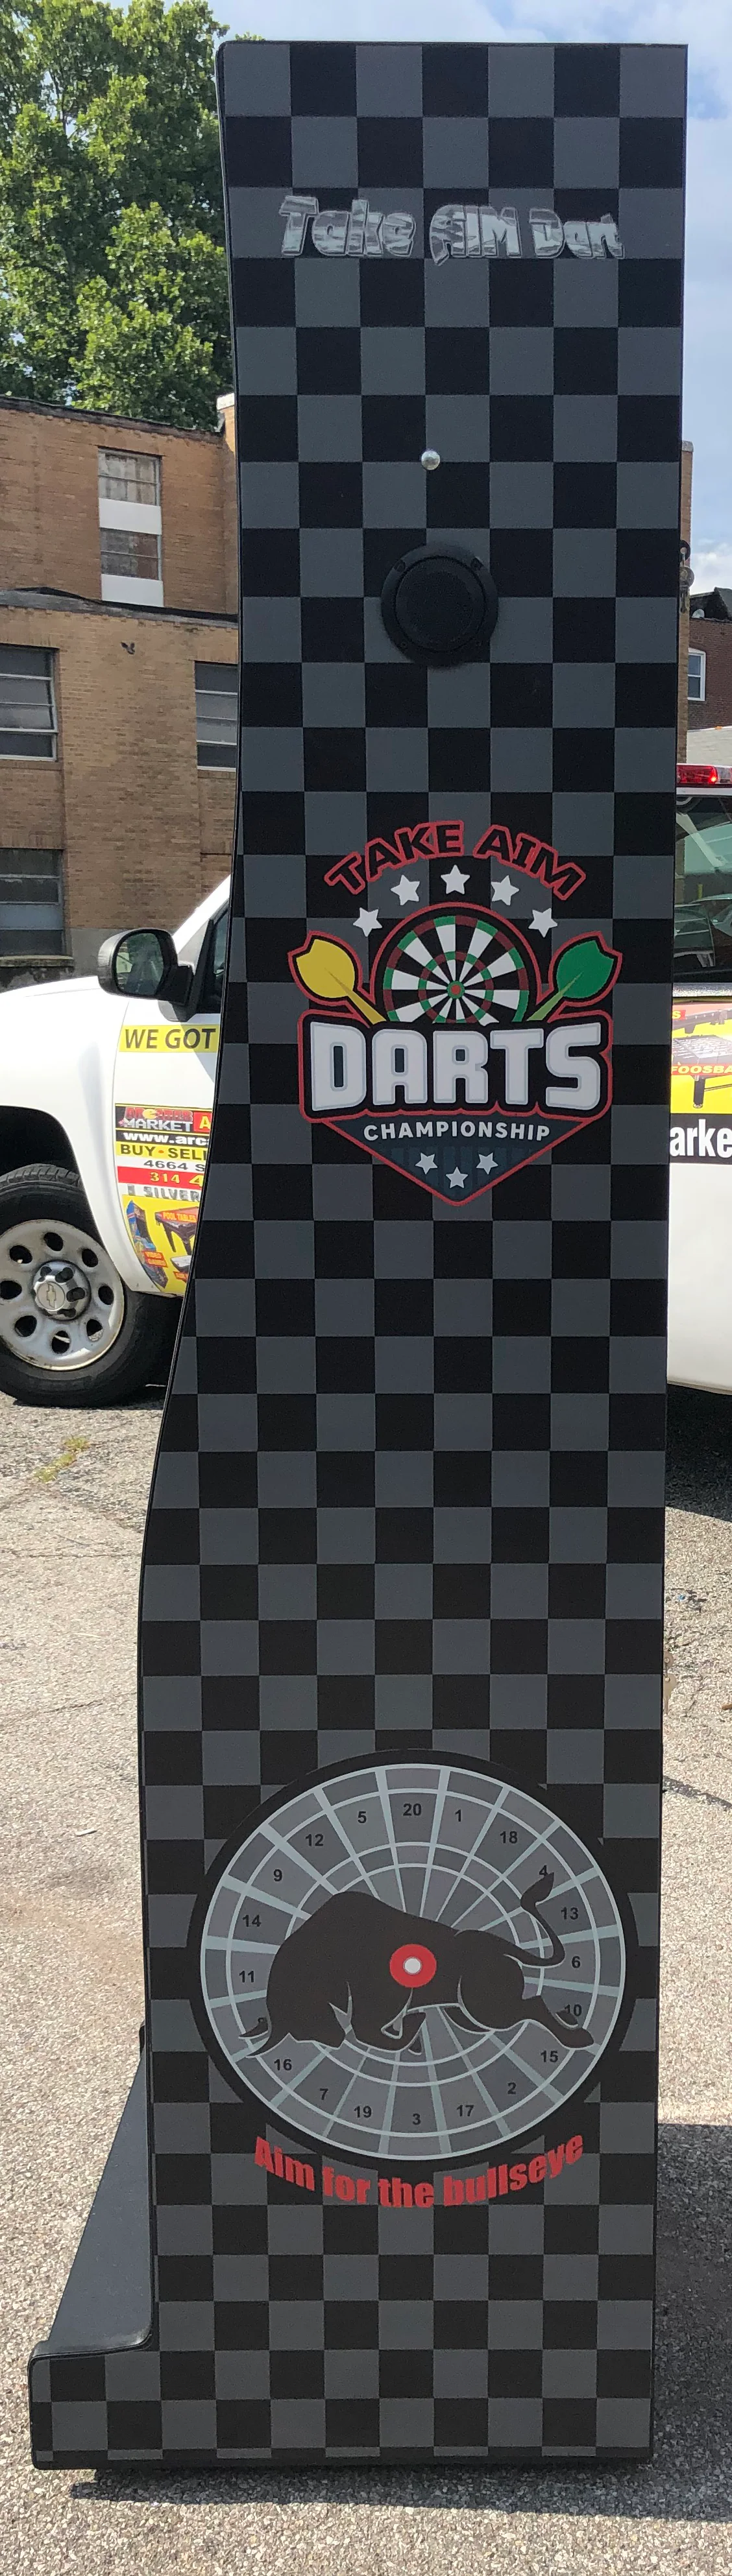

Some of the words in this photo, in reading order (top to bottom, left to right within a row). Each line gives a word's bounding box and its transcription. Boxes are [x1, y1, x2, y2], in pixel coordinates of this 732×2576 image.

[279, 195, 416, 257] Take
[325, 820, 464, 894] TAKE
[472, 824, 585, 900] AIM
[125, 1029, 159, 1049] WE
[165, 1029, 216, 1049] GOT
[310, 1021, 601, 1111] DARTS
[363, 1121, 550, 1141] CHAMPIONSHIP
[123, 1132, 209, 1145] www.arc
[121, 1144, 156, 1156] BUY
[144, 1160, 188, 1170] 4664
[150, 1172, 180, 1184] 314
[403, 1803, 422, 1817] 20
[455, 1809, 461, 1822] 1
[358, 1811, 367, 1824] 5
[305, 1834, 324, 1846] 12
[500, 1831, 518, 1844] 18
[273, 1869, 283, 1881] 9
[561, 1907, 579, 1920] 13
[243, 1914, 262, 1927] 14
[571, 1956, 581, 1968] 6
[239, 1970, 254, 1983] 11
[564, 2004, 582, 2016] 10
[540, 2050, 559, 2063] 15
[274, 2058, 292, 2071] 16
[319, 2088, 328, 2101] 7
[507, 2082, 517, 2095] 2
[354, 2106, 372, 2118] 19
[457, 2105, 474, 2117] 17
[412, 2113, 421, 2125] 3
[254, 2136, 315, 2191] Aim
[322, 2166, 371, 2204] for
[378, 2178, 434, 2208] the
[443, 2134, 583, 2206] bullseye
